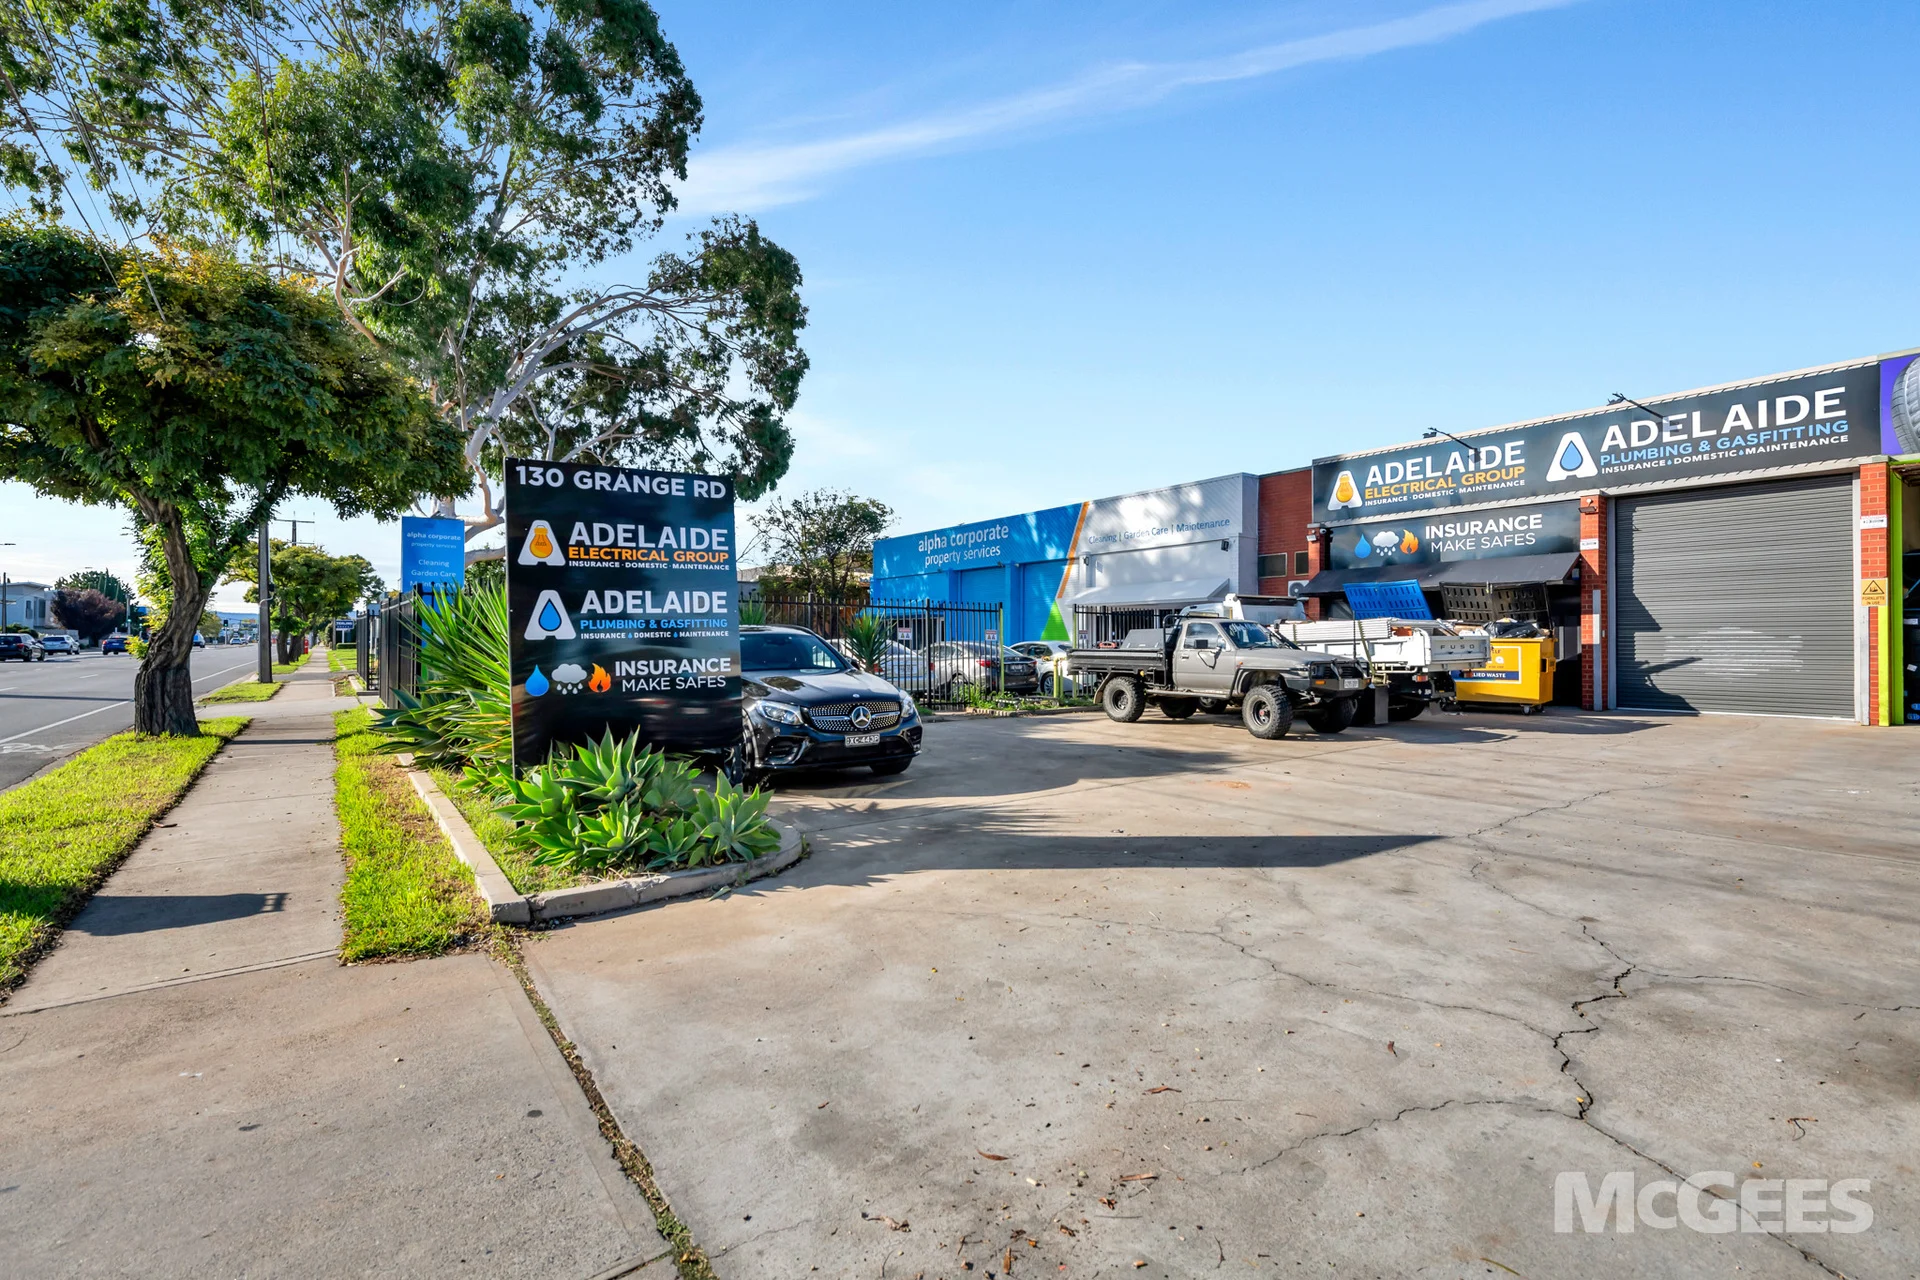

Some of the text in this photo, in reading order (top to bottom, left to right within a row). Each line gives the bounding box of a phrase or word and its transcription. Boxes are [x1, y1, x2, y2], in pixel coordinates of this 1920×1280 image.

[1600, 387, 1847, 452] ADELAIDE
[1600, 419, 1849, 466] PLUMBING & GASFITTING
[1601, 434, 1849, 474] INSURANCE DOMESTIC MAINTENANCE
[1365, 440, 1525, 488] ADELAIDE
[515, 466, 726, 499] 130 GRANGE RD
[1364, 465, 1526, 500] ELECTRICAL GROUP
[1364, 479, 1526, 507] INSURANCE DOMESTIC MAINTENANCE
[406, 531, 461, 541] alpha corporate
[568, 521, 729, 551] ADELAIDE
[1088, 519, 1230, 545] Cleaning Garden Care Maintenance
[1425, 513, 1543, 539] INSURANCE
[918, 524, 1009, 555] alpha corporate
[1431, 532, 1536, 553] MAKE SAFES
[418, 559, 450, 568] Cleaning
[568, 547, 729, 563] ELECTRICAL GROUP
[672, 563, 730, 571] MAINTENANCE
[925, 544, 1001, 569] property services
[411, 569, 438, 577] Garden
[580, 590, 728, 614] ADELAIDE
[580, 619, 728, 630] PLUMBING & GASFITTING
[615, 657, 731, 677] INSURANCE
[622, 675, 726, 692] MAKE SAFES
